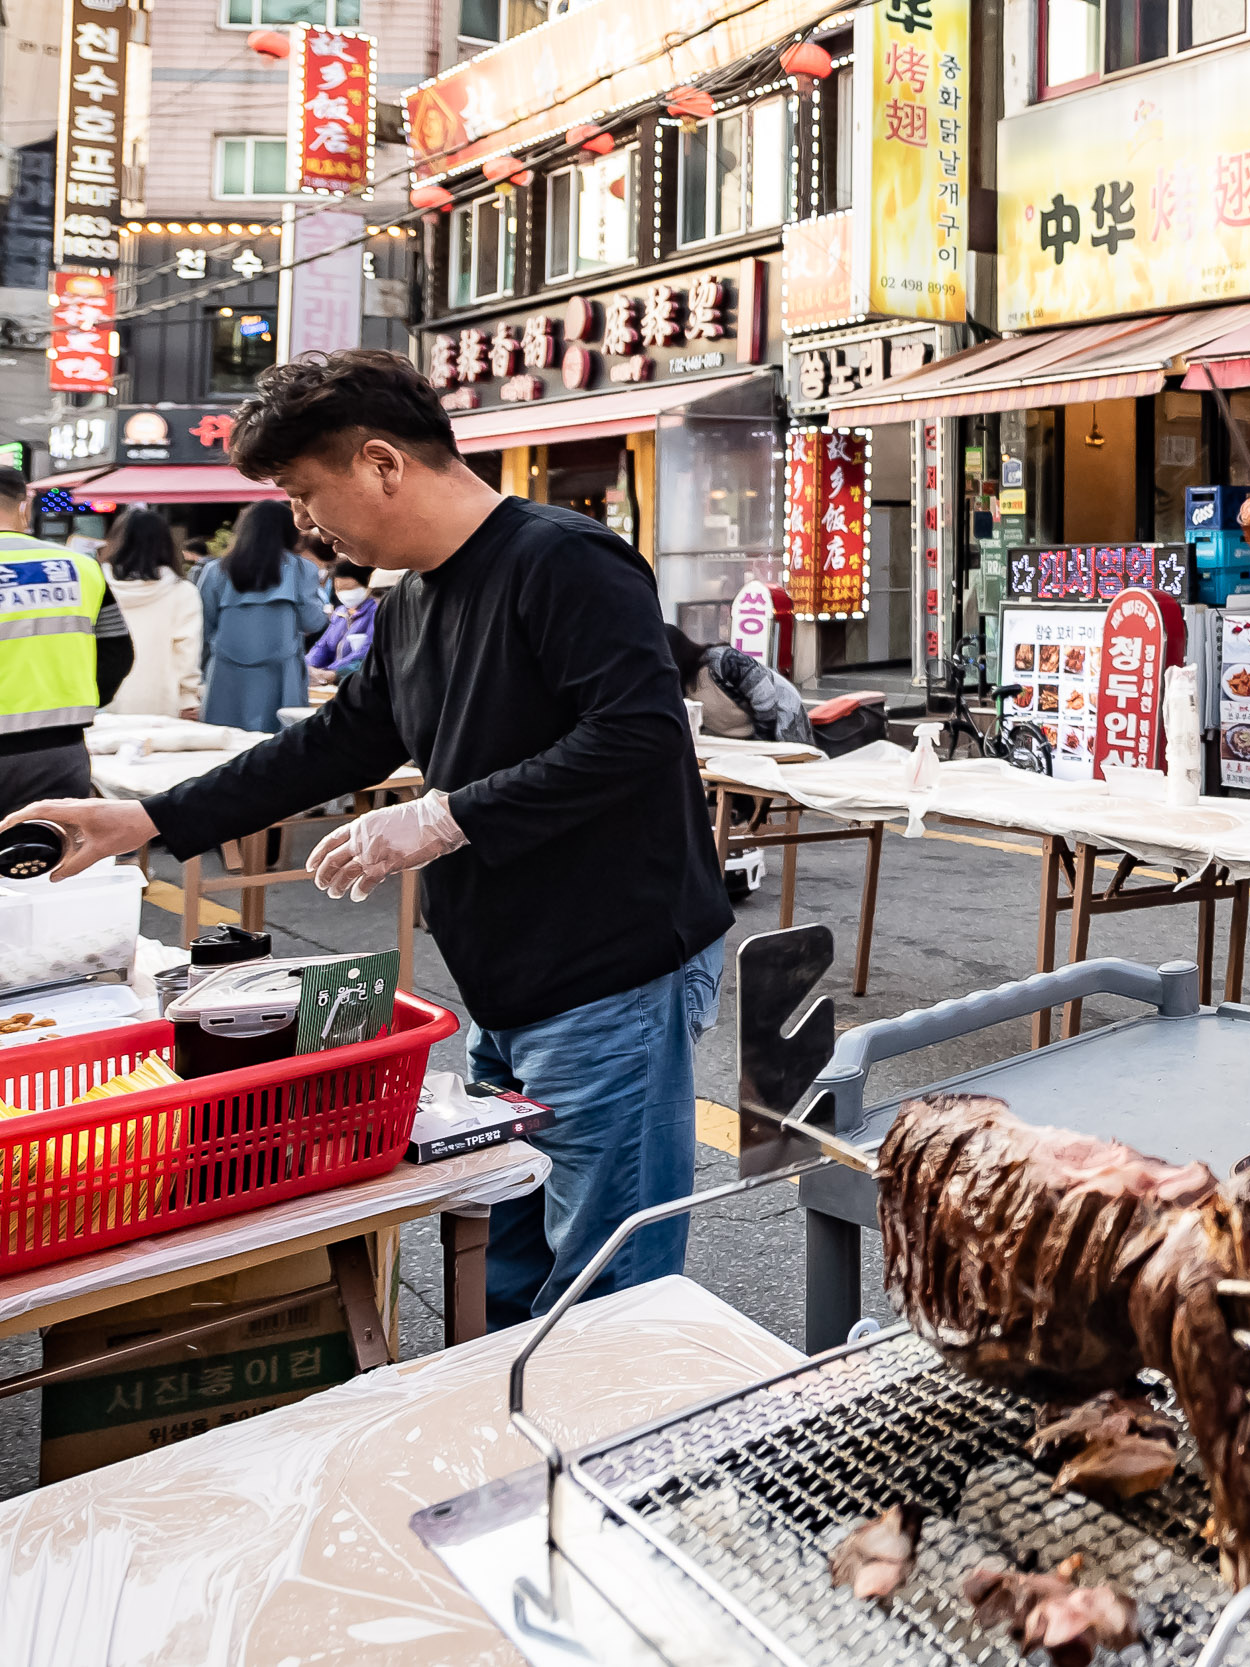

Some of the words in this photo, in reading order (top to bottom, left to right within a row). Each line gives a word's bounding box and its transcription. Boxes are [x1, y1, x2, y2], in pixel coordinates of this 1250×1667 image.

[72, 21, 119, 184] 천수호프
[67, 182, 119, 207] HOF
[938, 54, 961, 270] 중화닭날개구이
[880, 276, 896, 289] 02
[900, 278, 923, 291] 498
[927, 282, 956, 296] 8999
[823, 434, 851, 571] 故乡饭店
[465, 1129, 501, 1147] TPE장갑
[106, 1346, 322, 1415] 서진종이컵
